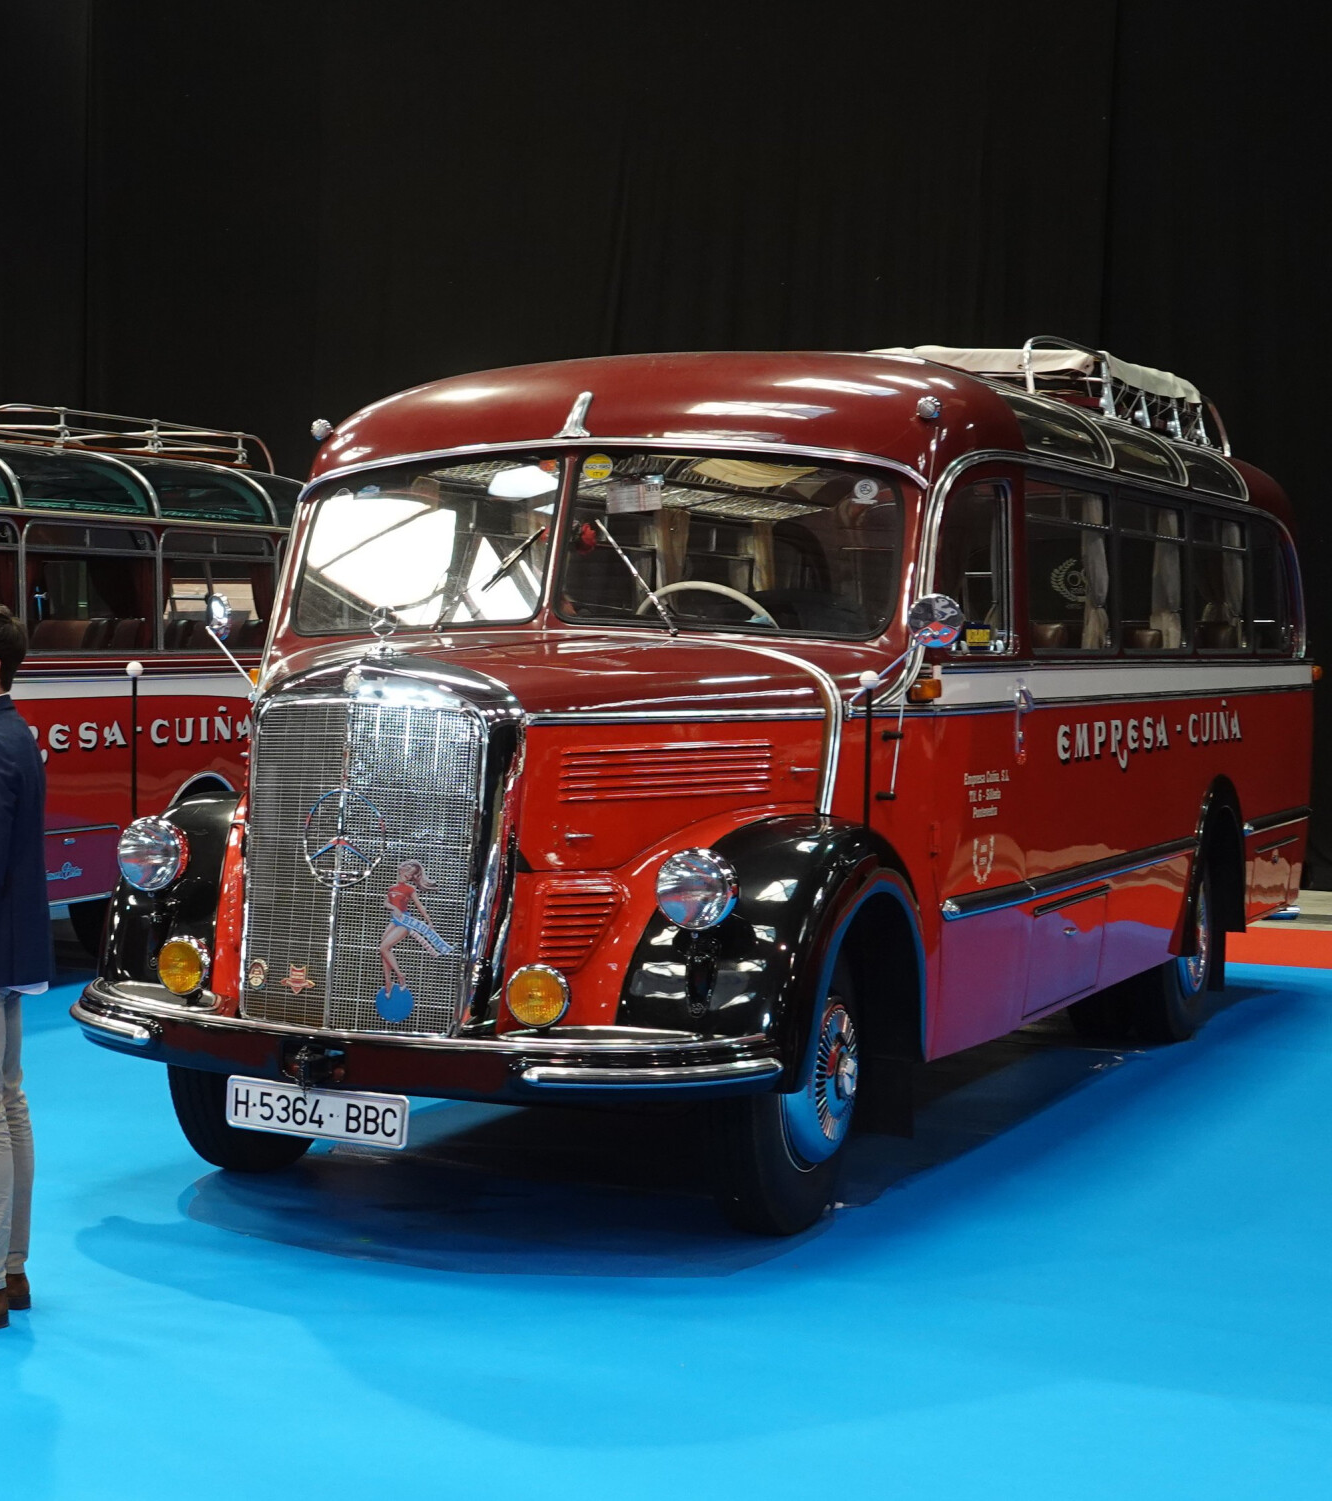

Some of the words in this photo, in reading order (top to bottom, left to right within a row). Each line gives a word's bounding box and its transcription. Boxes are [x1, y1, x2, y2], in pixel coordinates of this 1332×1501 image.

[150, 705, 251, 745] CUIÑA
[1057, 713, 1168, 769] EMPRESA
[1188, 699, 1242, 743] CUIÑA
